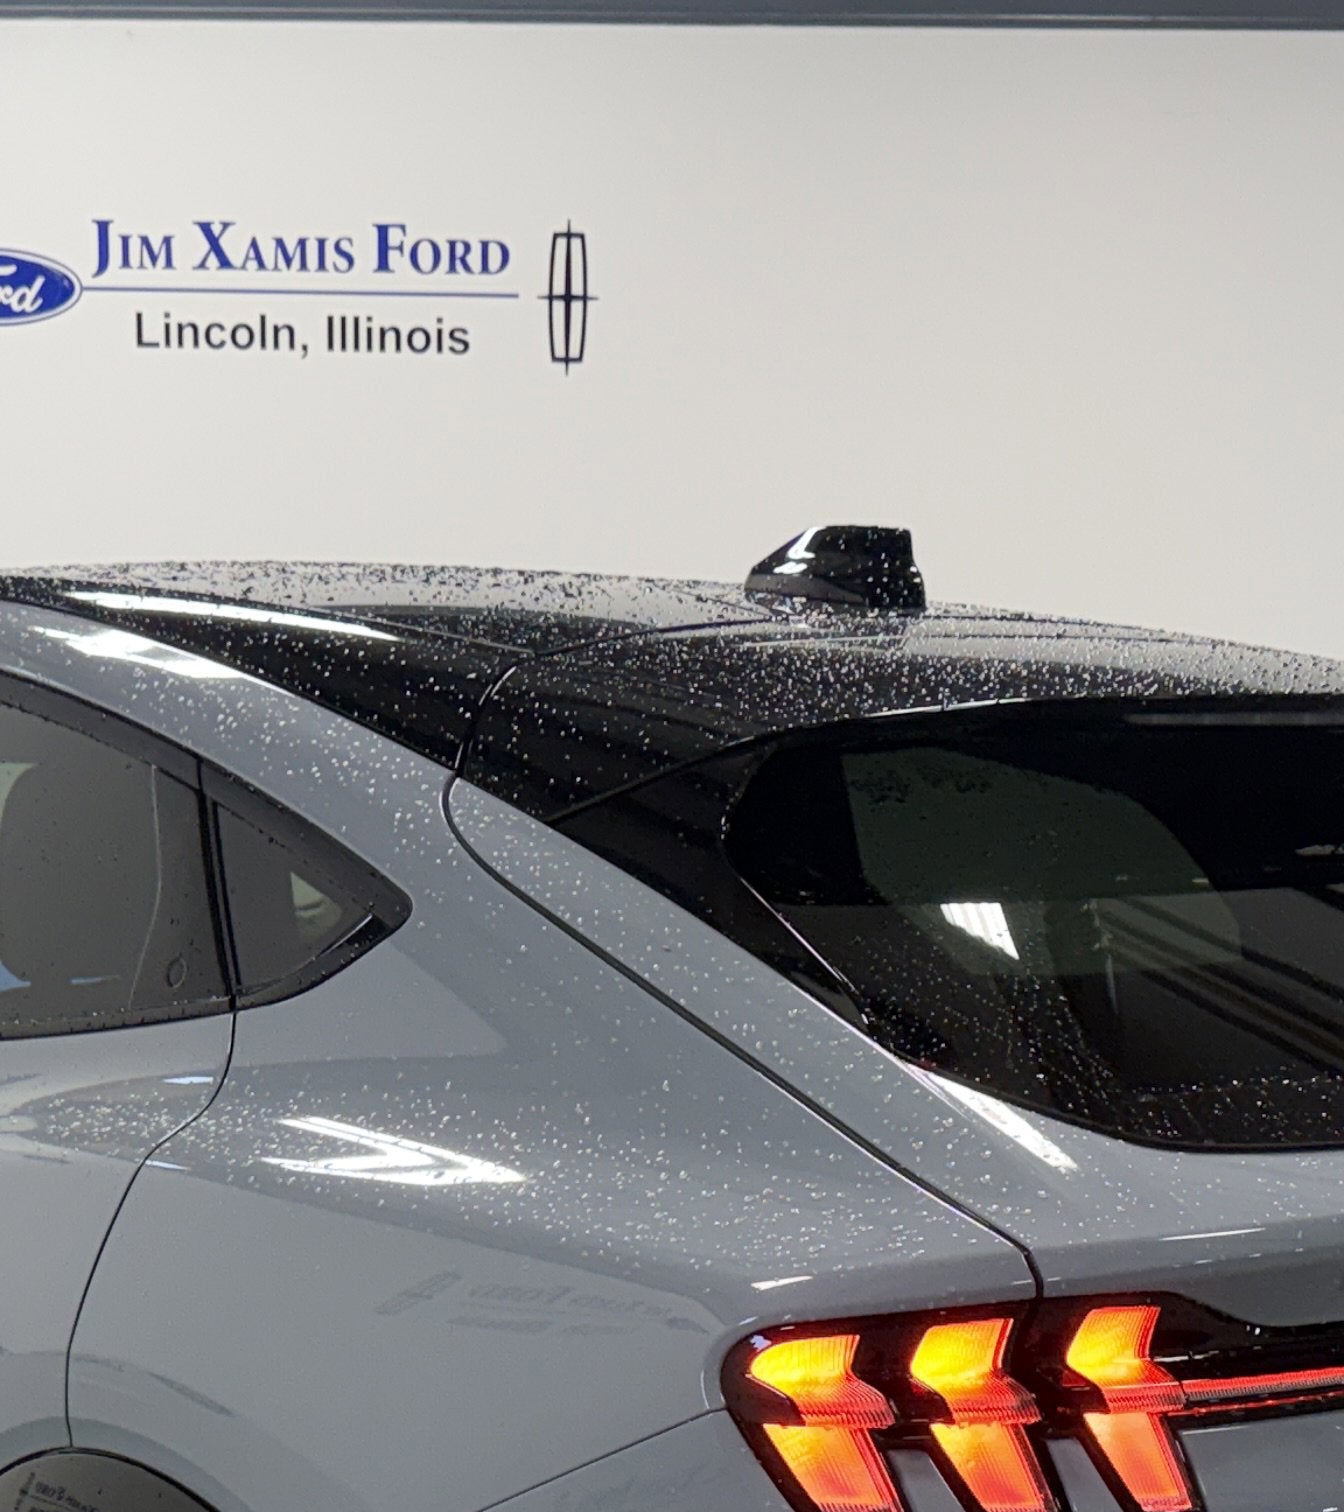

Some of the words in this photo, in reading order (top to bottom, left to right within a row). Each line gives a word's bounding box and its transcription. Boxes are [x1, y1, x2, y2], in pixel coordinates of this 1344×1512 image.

[91, 218, 176, 279] JIM
[192, 220, 356, 274] XAMIS
[372, 222, 511, 277] FORD
[135, 311, 309, 359] Lincoln,
[326, 314, 471, 356] Illinois
